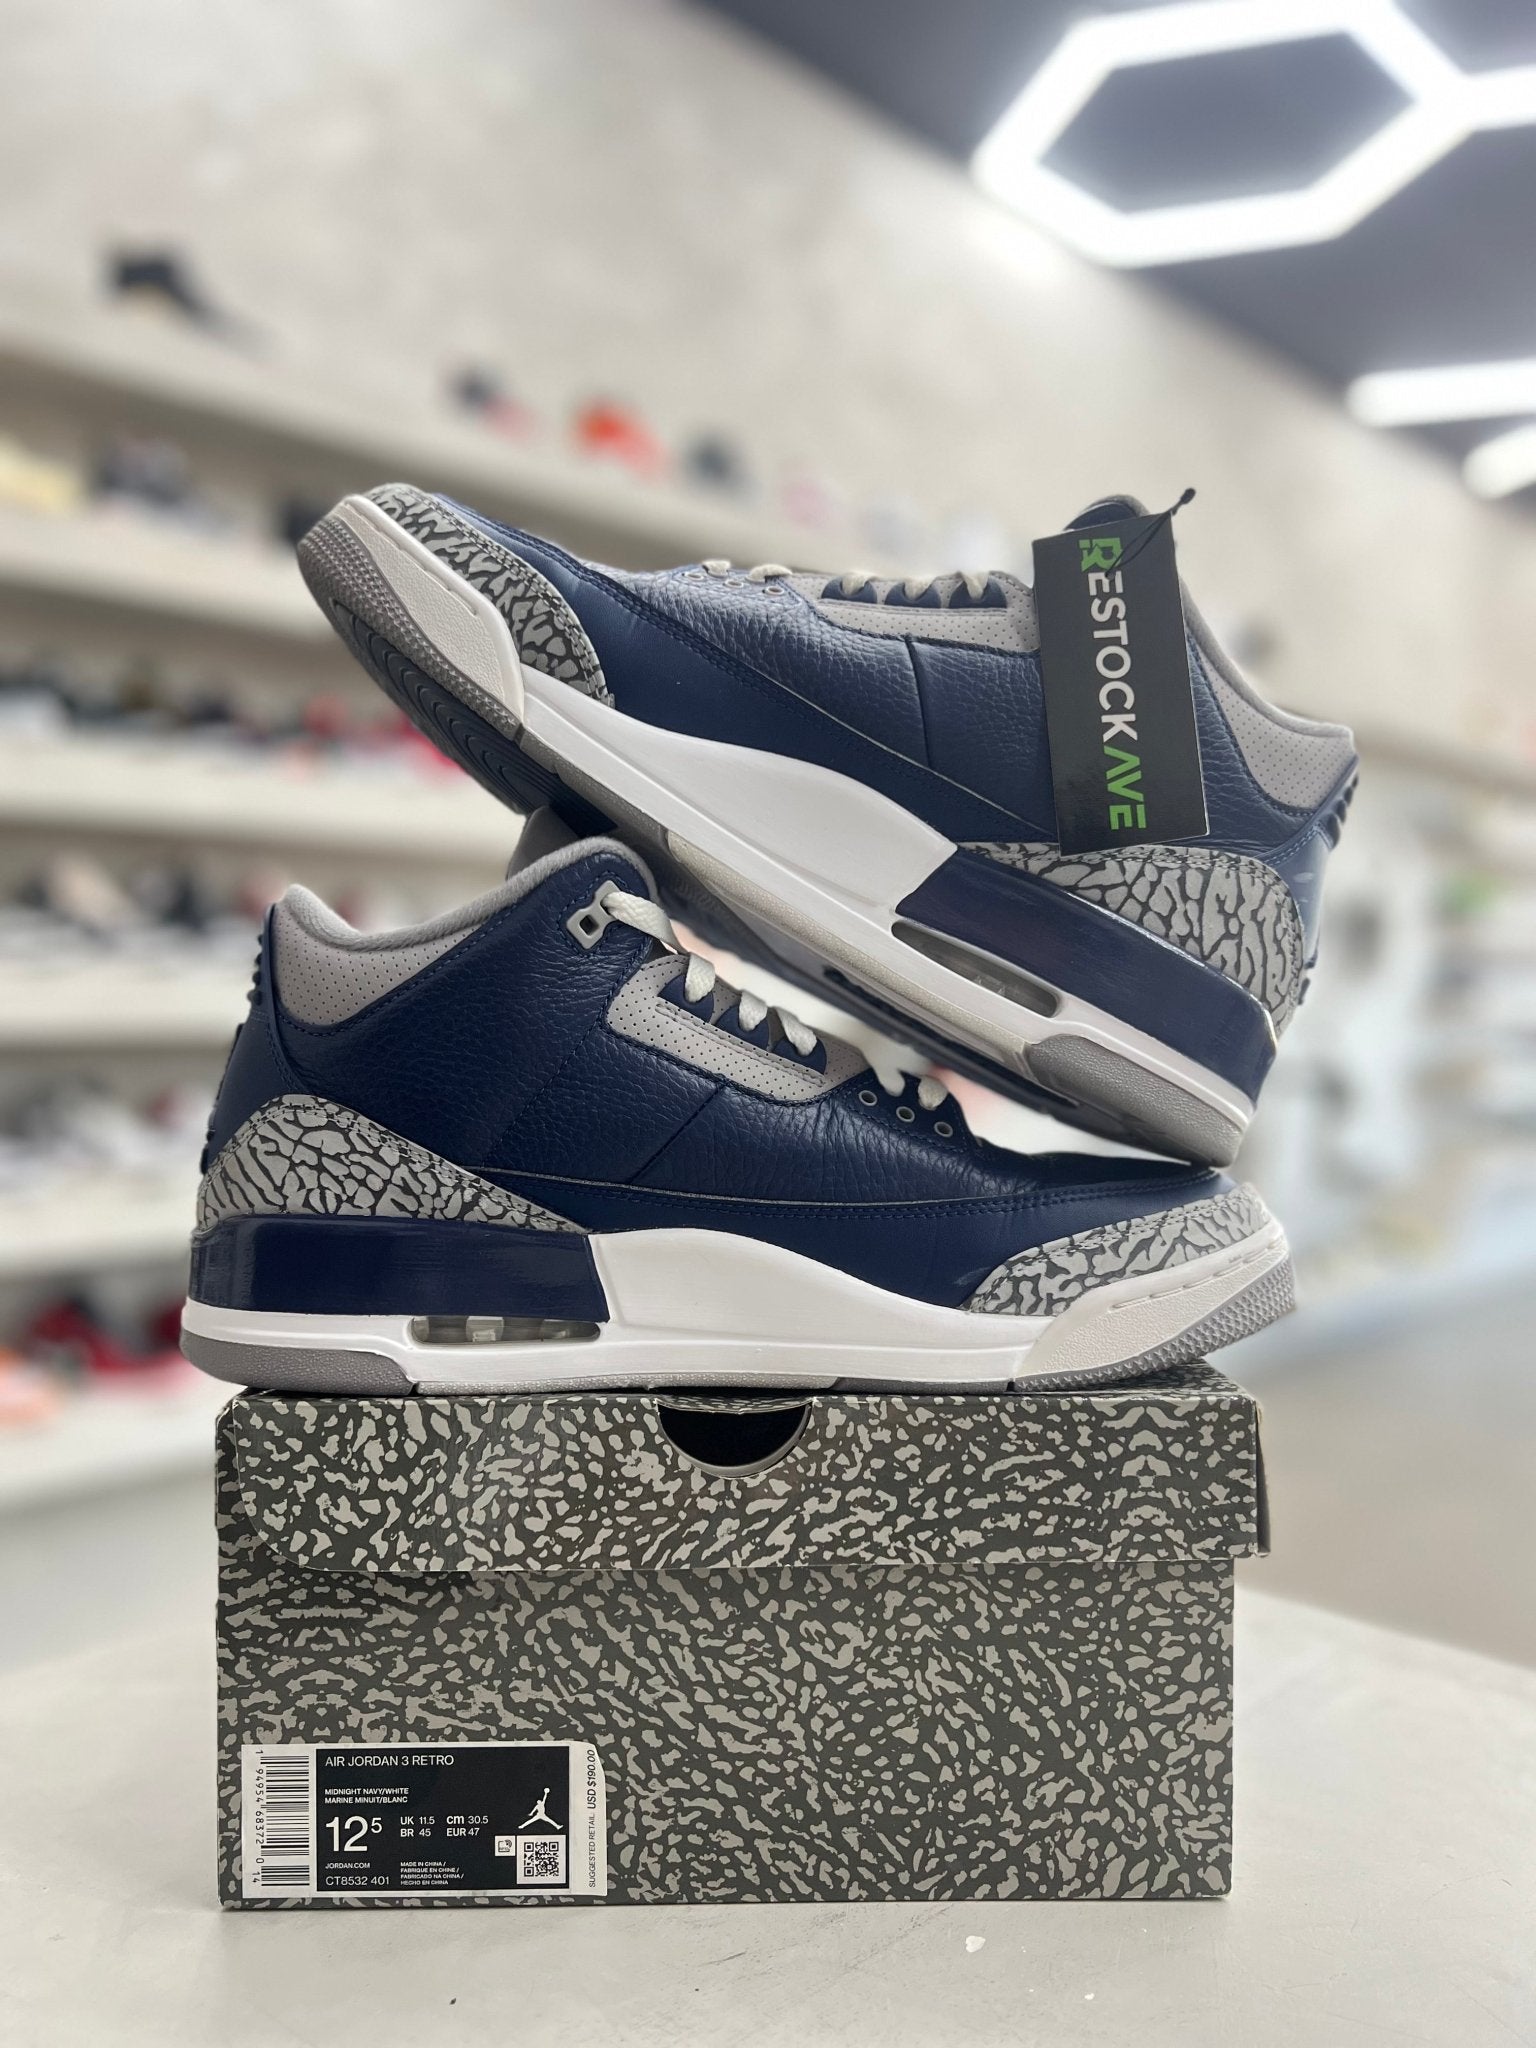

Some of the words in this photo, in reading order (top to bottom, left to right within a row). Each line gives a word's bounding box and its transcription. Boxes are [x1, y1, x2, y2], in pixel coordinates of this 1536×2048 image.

[325, 1756, 345, 1767] AIR
[348, 1755, 399, 1767] JORDAN
[401, 1755, 409, 1766] 3
[412, 1754, 455, 1766] RETRO
[586, 1749, 597, 1787] $190.00
[255, 1768, 265, 1803] 94954
[363, 1787, 410, 1795] NAVY/WHITE
[355, 1796, 408, 1804] MINUIT/BLANC
[586, 1788, 597, 1809] USD
[400, 1816, 414, 1825] UK
[419, 1816, 435, 1825] 11.5
[446, 1816, 464, 1825] cm
[467, 1815, 489, 1825] 30.5
[255, 1810, 266, 1845] 68372
[400, 1829, 414, 1838] BR
[419, 1828, 431, 1837] 45
[446, 1828, 466, 1837] EUR
[467, 1827, 480, 1836] 47
[588, 1813, 596, 1841] RETAIL
[588, 1847, 596, 1888] SUGGESTED
[252, 1871, 260, 1883] 14
[325, 1876, 368, 1886] CT8532
[370, 1876, 390, 1885] 401
